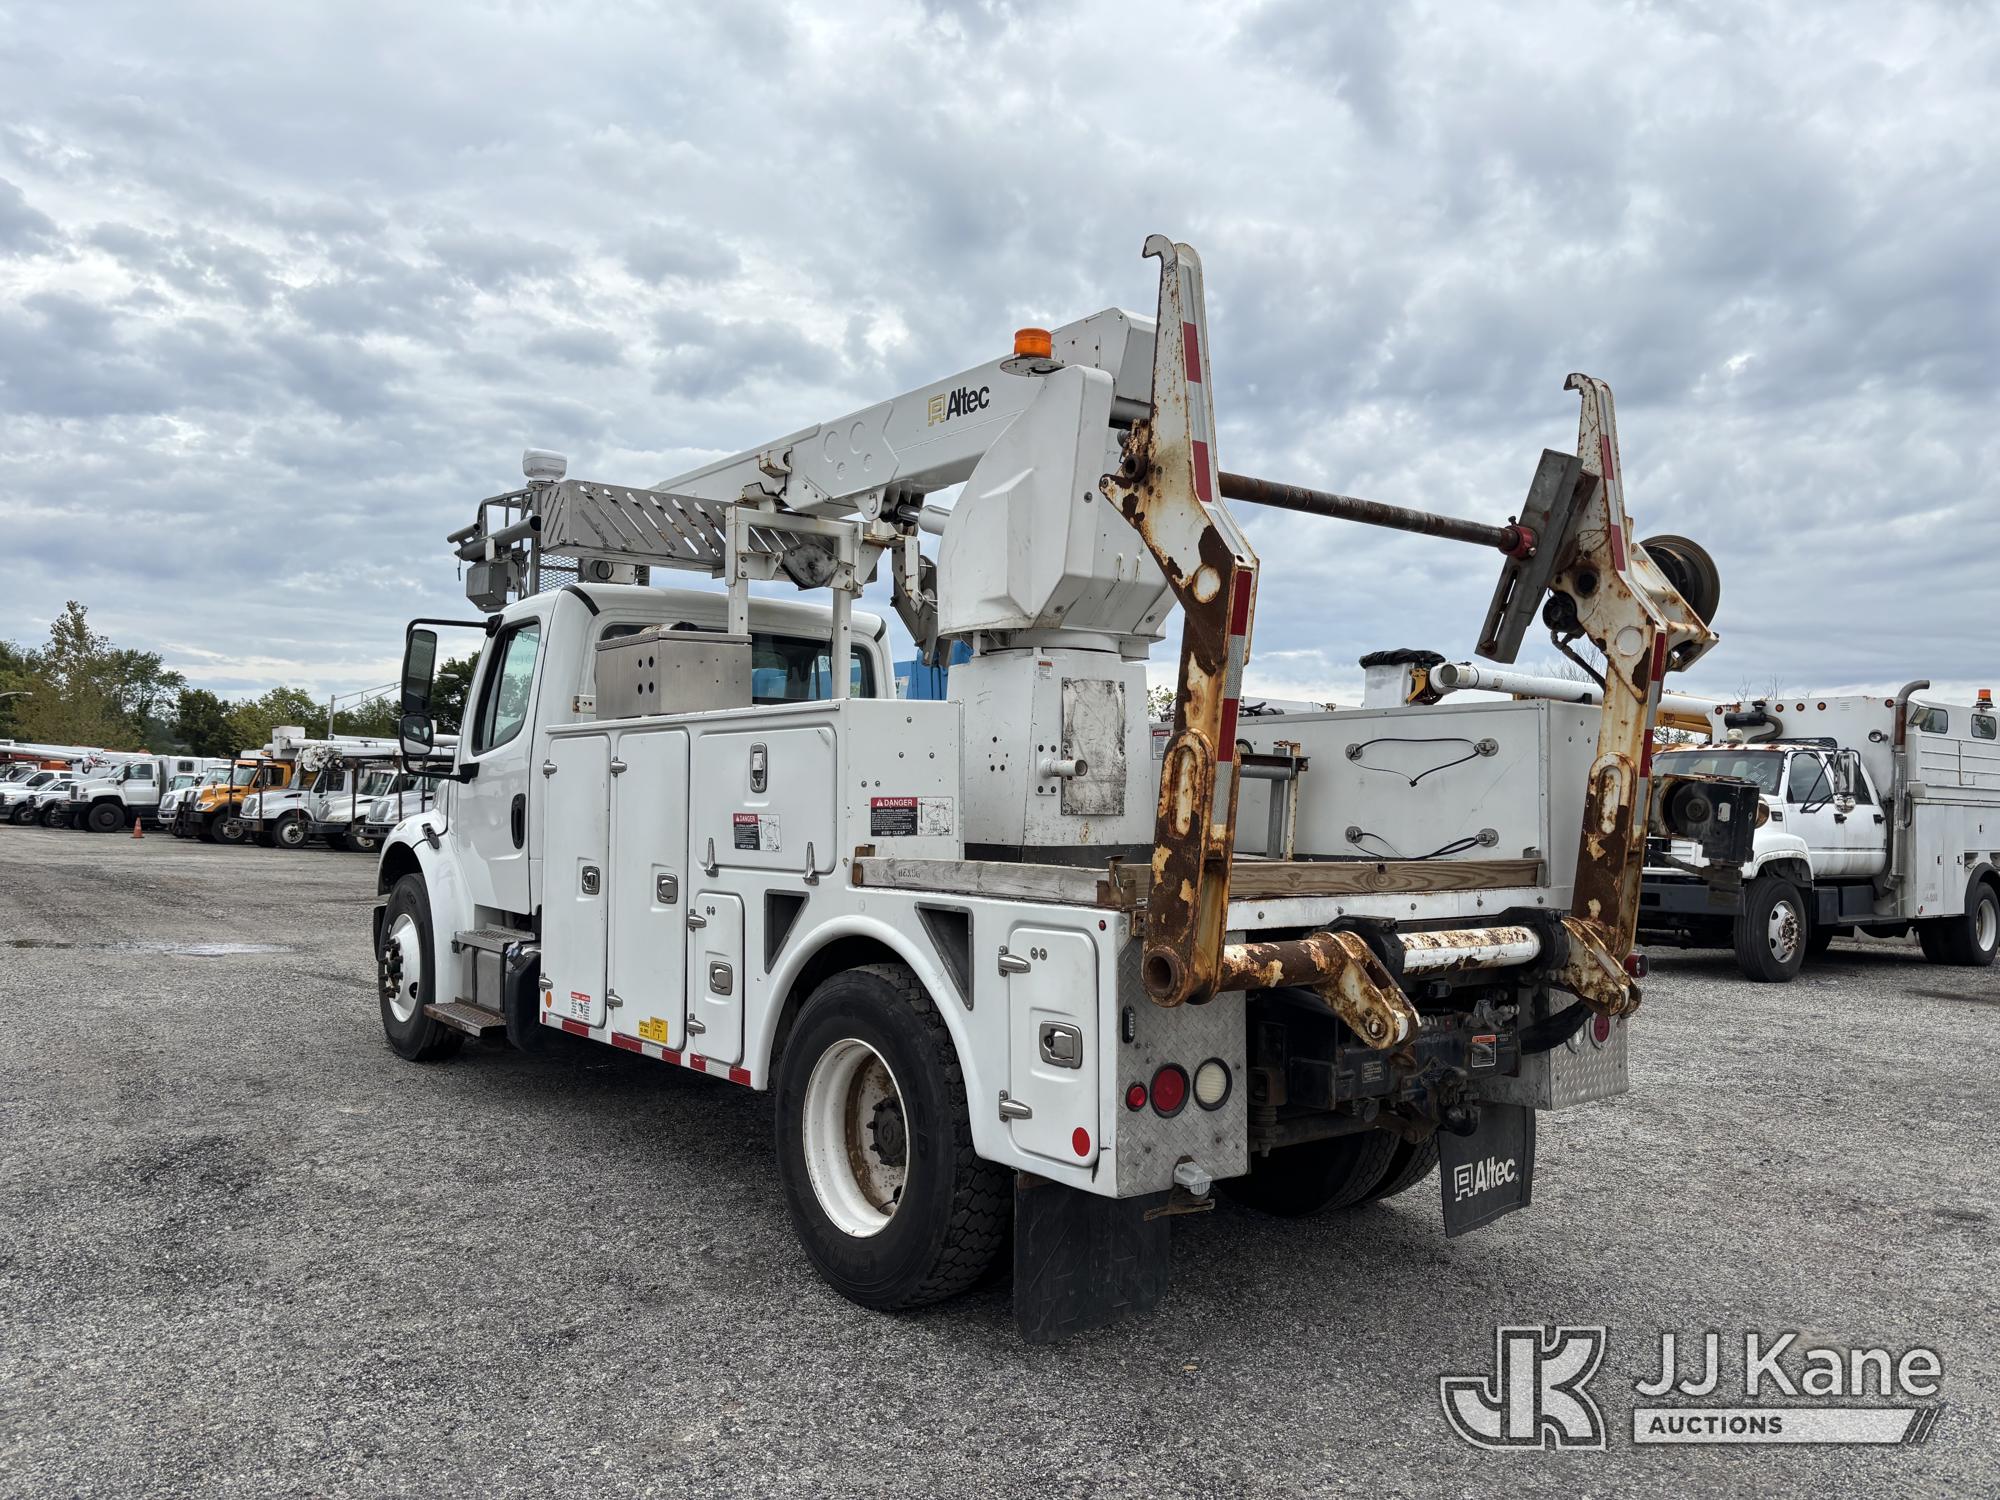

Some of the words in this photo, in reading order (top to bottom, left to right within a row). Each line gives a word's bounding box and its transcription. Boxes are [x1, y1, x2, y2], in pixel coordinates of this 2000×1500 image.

[945, 386, 990, 421] Altec
[884, 799, 913, 807] DANGER
[739, 815, 756, 823] DANGER
[1473, 1156, 1516, 1196] Altec
